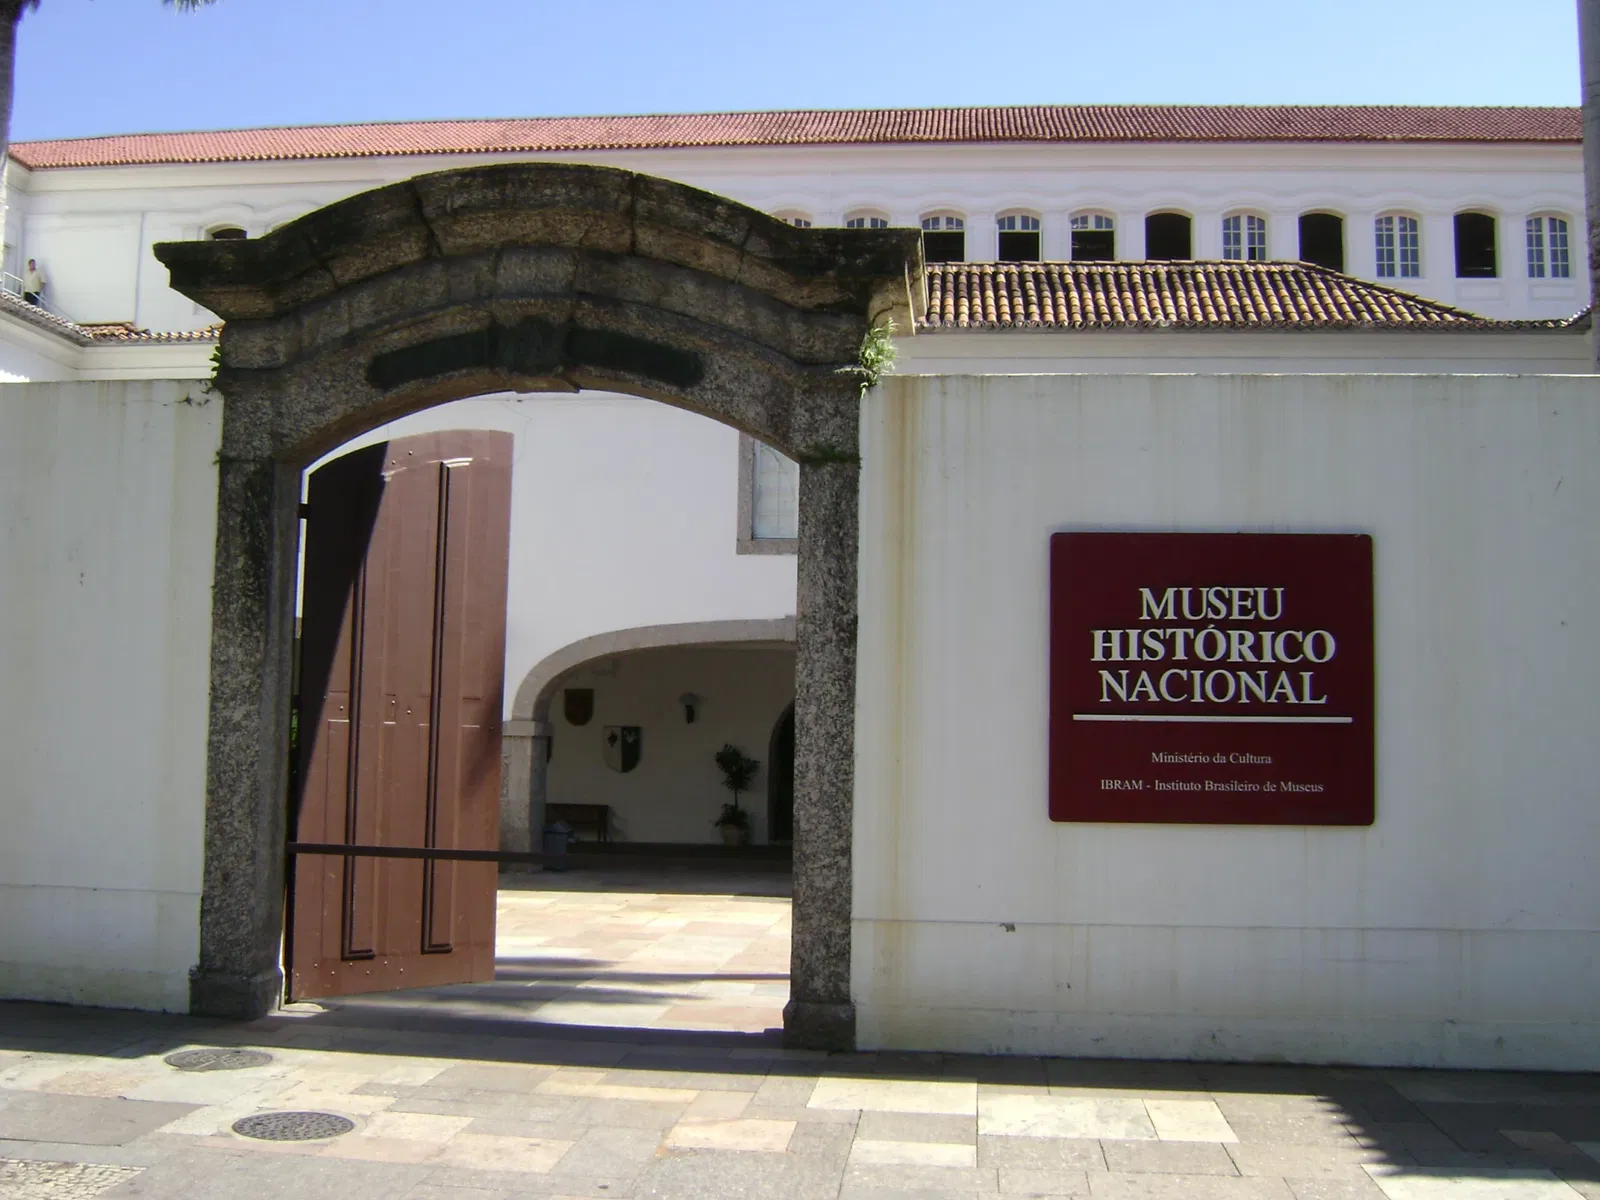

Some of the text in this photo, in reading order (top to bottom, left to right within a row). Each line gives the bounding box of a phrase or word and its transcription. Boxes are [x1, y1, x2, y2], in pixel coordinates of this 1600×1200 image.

[1138, 586, 1285, 621] MUSEU
[1090, 624, 1336, 663] HISTÓRICO
[1098, 668, 1328, 705] NACIONAL
[1151, 752, 1272, 766] Ministério da Cultura
[1100, 779, 1143, 791] IBRAM
[1154, 780, 1202, 793] Instituto
[1204, 780, 1260, 793] Brasileiro
[1262, 780, 1277, 793] de
[1279, 781, 1324, 794] Museus
